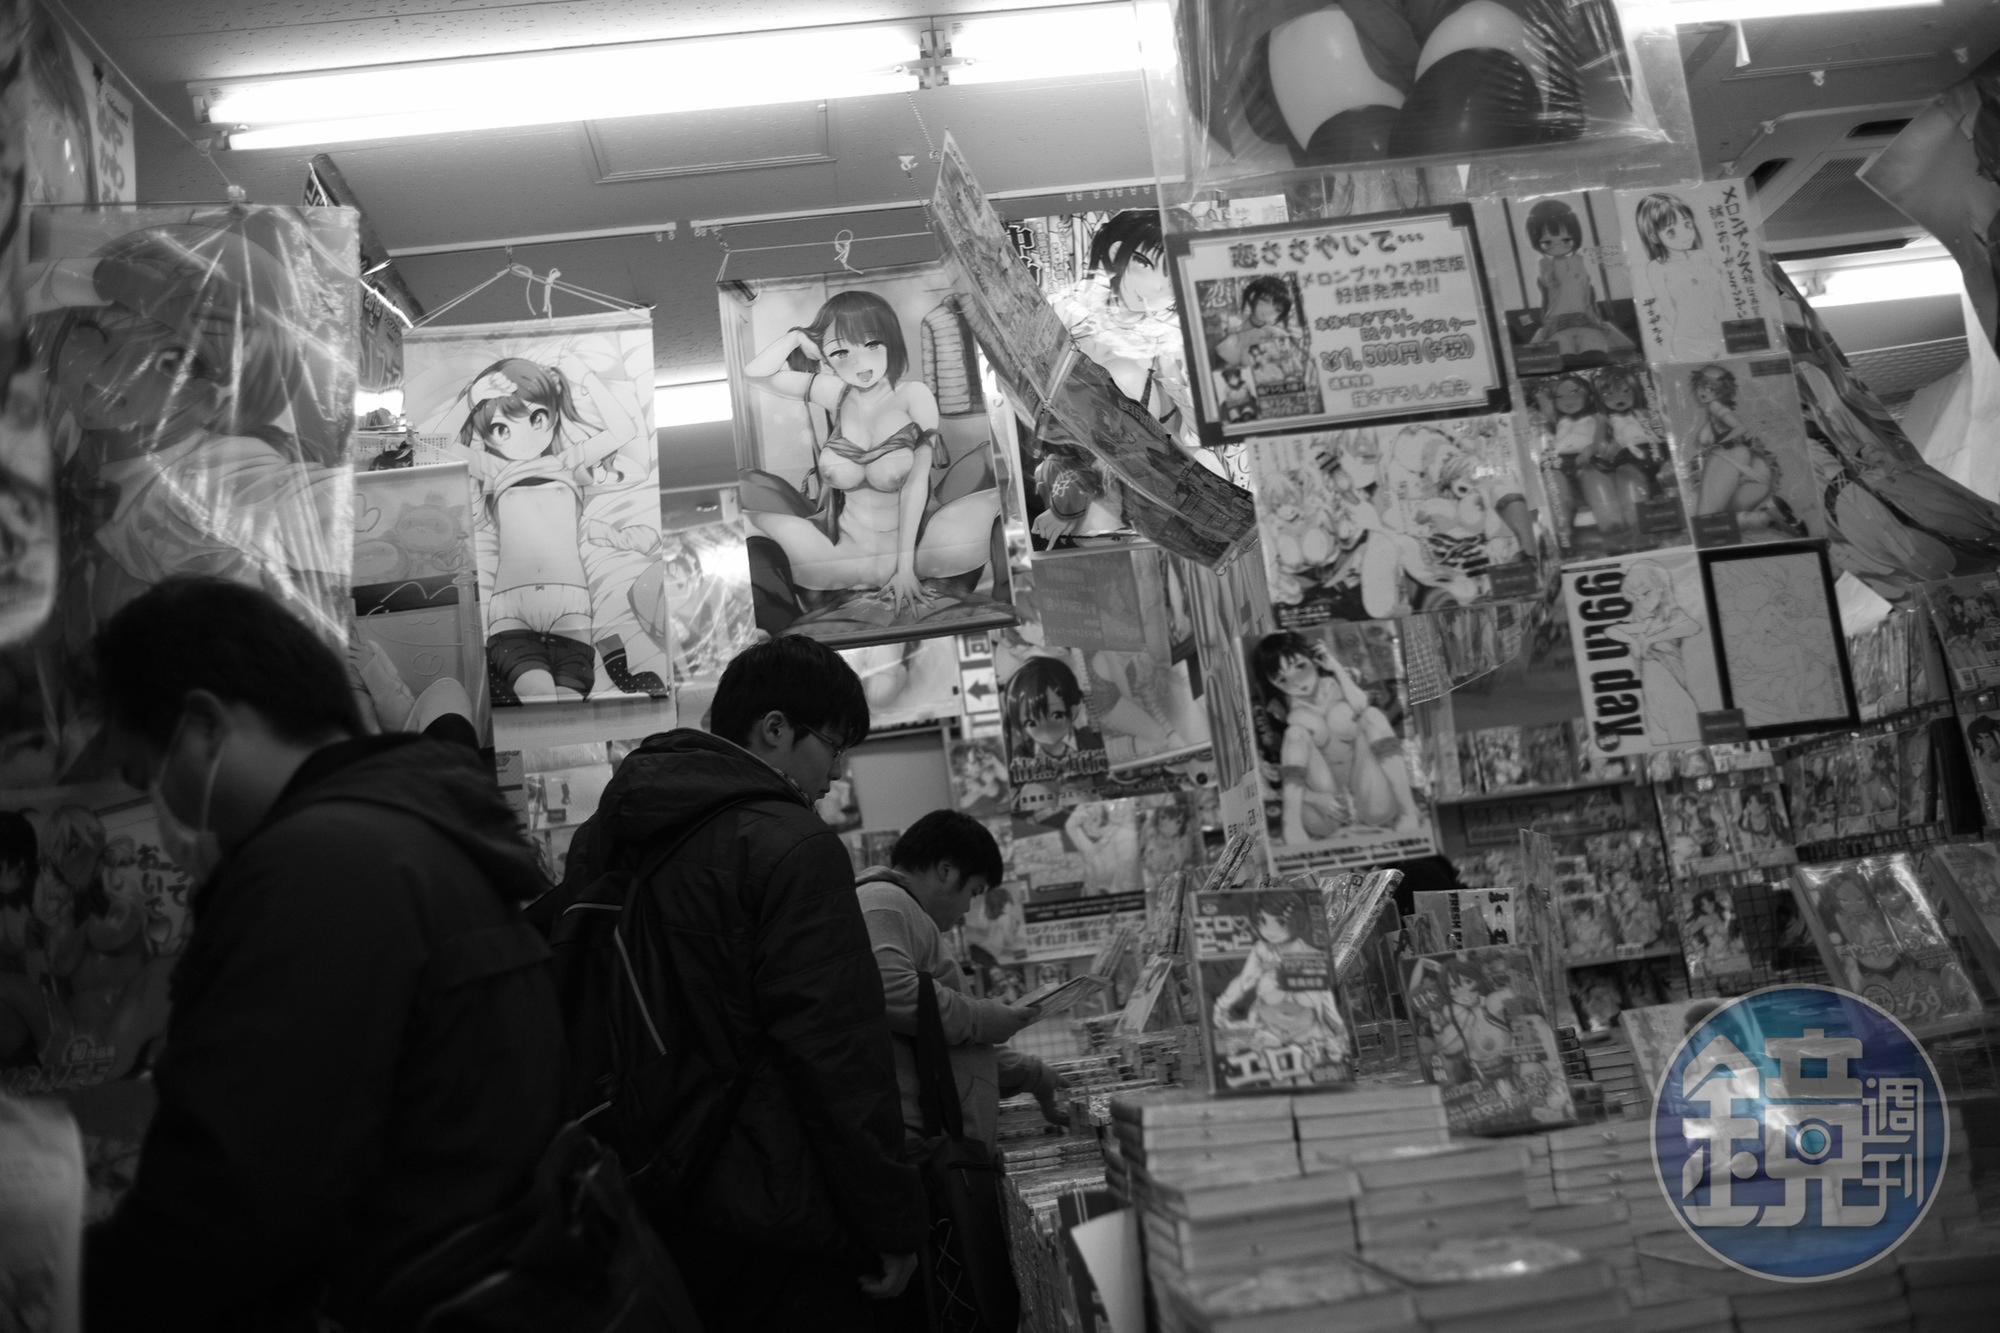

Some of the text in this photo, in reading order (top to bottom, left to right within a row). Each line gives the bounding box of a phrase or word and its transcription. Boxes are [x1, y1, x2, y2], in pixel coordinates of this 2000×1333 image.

[1302, 254, 1467, 287] メロンブックス限定版
[1590, 667, 1644, 738] day
